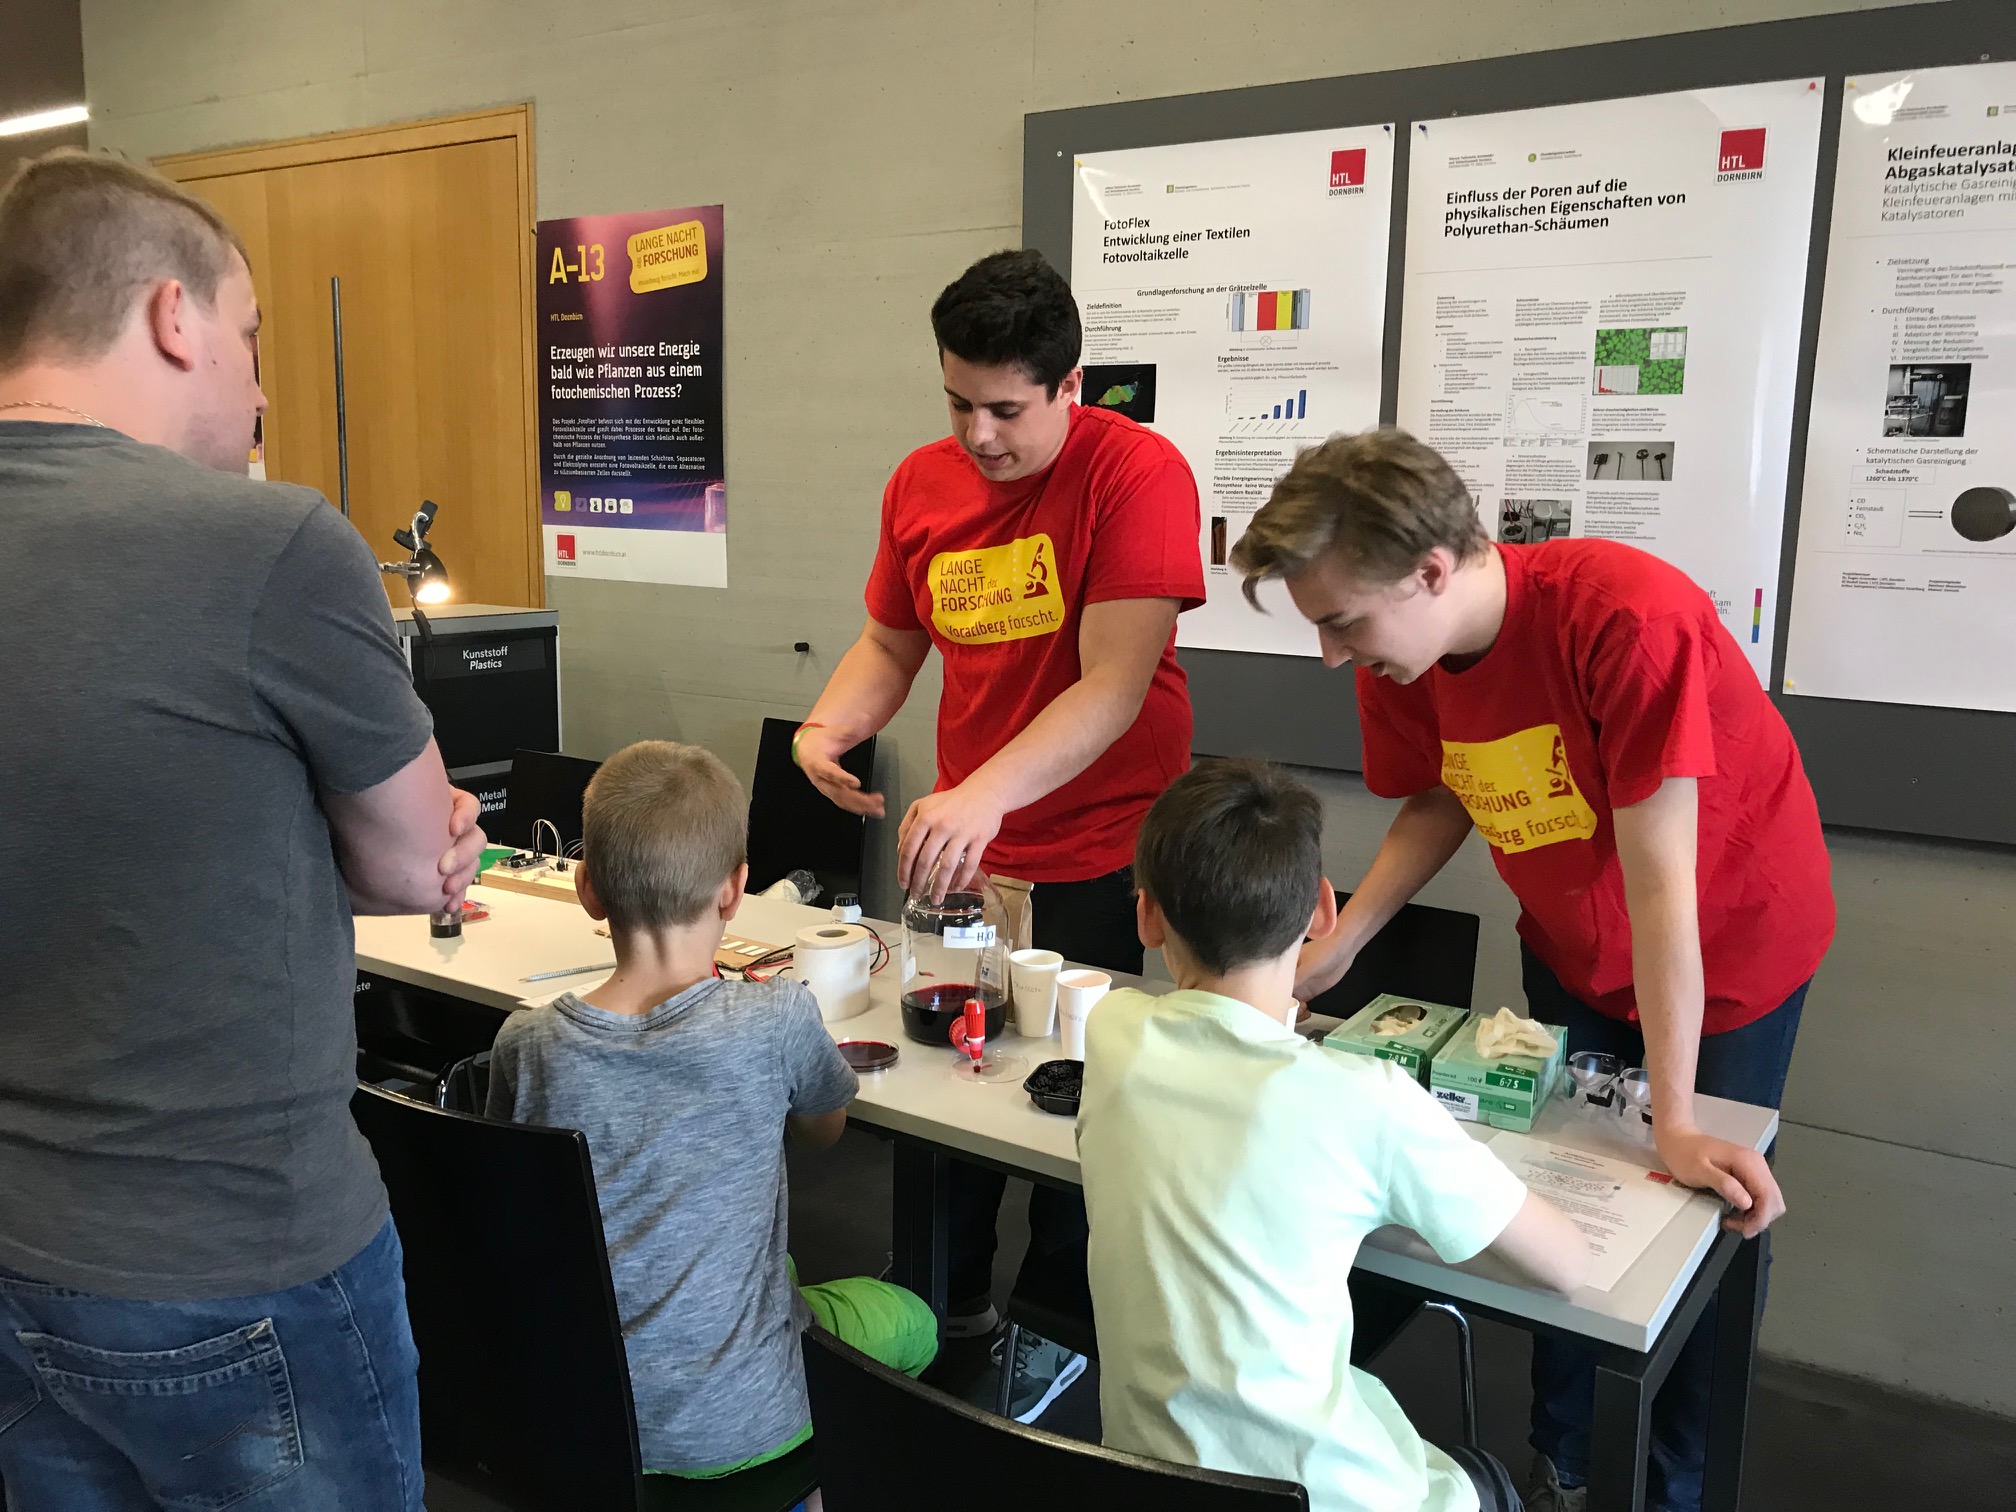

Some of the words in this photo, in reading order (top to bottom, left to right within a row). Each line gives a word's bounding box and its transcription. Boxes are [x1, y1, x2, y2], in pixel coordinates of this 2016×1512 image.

[1721, 155, 1746, 170] HTL
[1716, 171, 1763, 182] DORNBIRN
[1885, 159, 2016, 181] Abgaskatalysat
[1332, 172, 1351, 186] HTL
[1328, 186, 1365, 197] DORNBIRN
[1446, 189, 1499, 205] Einfluss
[1502, 186, 1527, 201] der
[1529, 183, 1573, 199] Poren
[1576, 179, 1602, 195] auf
[1604, 177, 1628, 193] die
[1883, 181, 1958, 195] Katalytische
[1882, 192, 1994, 209] Kleinfeueranlagen
[1999, 191, 2016, 202] mi
[1444, 200, 1546, 223] physikalischen
[1550, 196, 1653, 217] Eigenschaften
[1657, 193, 1687, 205] von
[1881, 208, 1965, 222] Katalysatoren
[1104, 217, 1151, 231] FotoFlex
[1444, 214, 1610, 239] Polyurethan-Schäumen
[635, 234, 664, 253] LANGE
[666, 227, 697, 246] NACHT
[1103, 229, 1170, 248] Entwicklung
[1172, 230, 1203, 243] einer
[1205, 226, 1251, 240] Textilen
[643, 243, 699, 267] FORSCHUNG
[1102, 247, 1190, 265] Fotovoltaikzelle
[1887, 258, 1930, 266] Zielsetzung
[549, 243, 605, 285] A-13
[1136, 285, 1205, 297] Grundlagenforschung
[1216, 285, 1228, 293] der
[1228, 283, 1268, 292] Grätzelzelle
[1882, 306, 1935, 315] Durchführung
[550, 345, 595, 363] Erzeugen
[598, 343, 616, 358] wir
[619, 344, 655, 357] unsere
[659, 340, 701, 360] Energie
[1218, 355, 1250, 363] Ergebnisse
[550, 364, 572, 380] bald
[576, 365, 594, 379] wie
[598, 364, 643, 379] Pflanzen
[646, 366, 665, 378] aus
[669, 362, 702, 377] einem
[551, 384, 631, 400] fotochemischen
[634, 384, 683, 399] Prozess?
[1215, 449, 1282, 457] Ergebnisinterpretation
[1866, 447, 1918, 455] Schematische
[1920, 447, 1963, 456] Darstellung
[1866, 457, 1915, 465] katalytischen
[1916, 457, 1967, 466] Gasreinigung
[558, 549, 569, 559] HTL
[940, 558, 984, 576] LANGE
[940, 576, 986, 595] NACHT
[987, 577, 999, 590] der
[941, 587, 1013, 612] FORSCHUNG
[944, 620, 1007, 639] Vorarlberg
[1008, 609, 1059, 631] forscht.
[462, 646, 508, 660] Kunststoff
[469, 659, 503, 671] Plastics
[1478, 779, 1497, 792] der
[479, 788, 507, 802] Metall
[481, 799, 507, 813] Metal
[1400, 1055, 1408, 1065] M
[1499, 1077, 1512, 1087] 6-7
[1513, 1080, 1519, 1089] S
[1436, 1091, 1466, 1103] zeller
